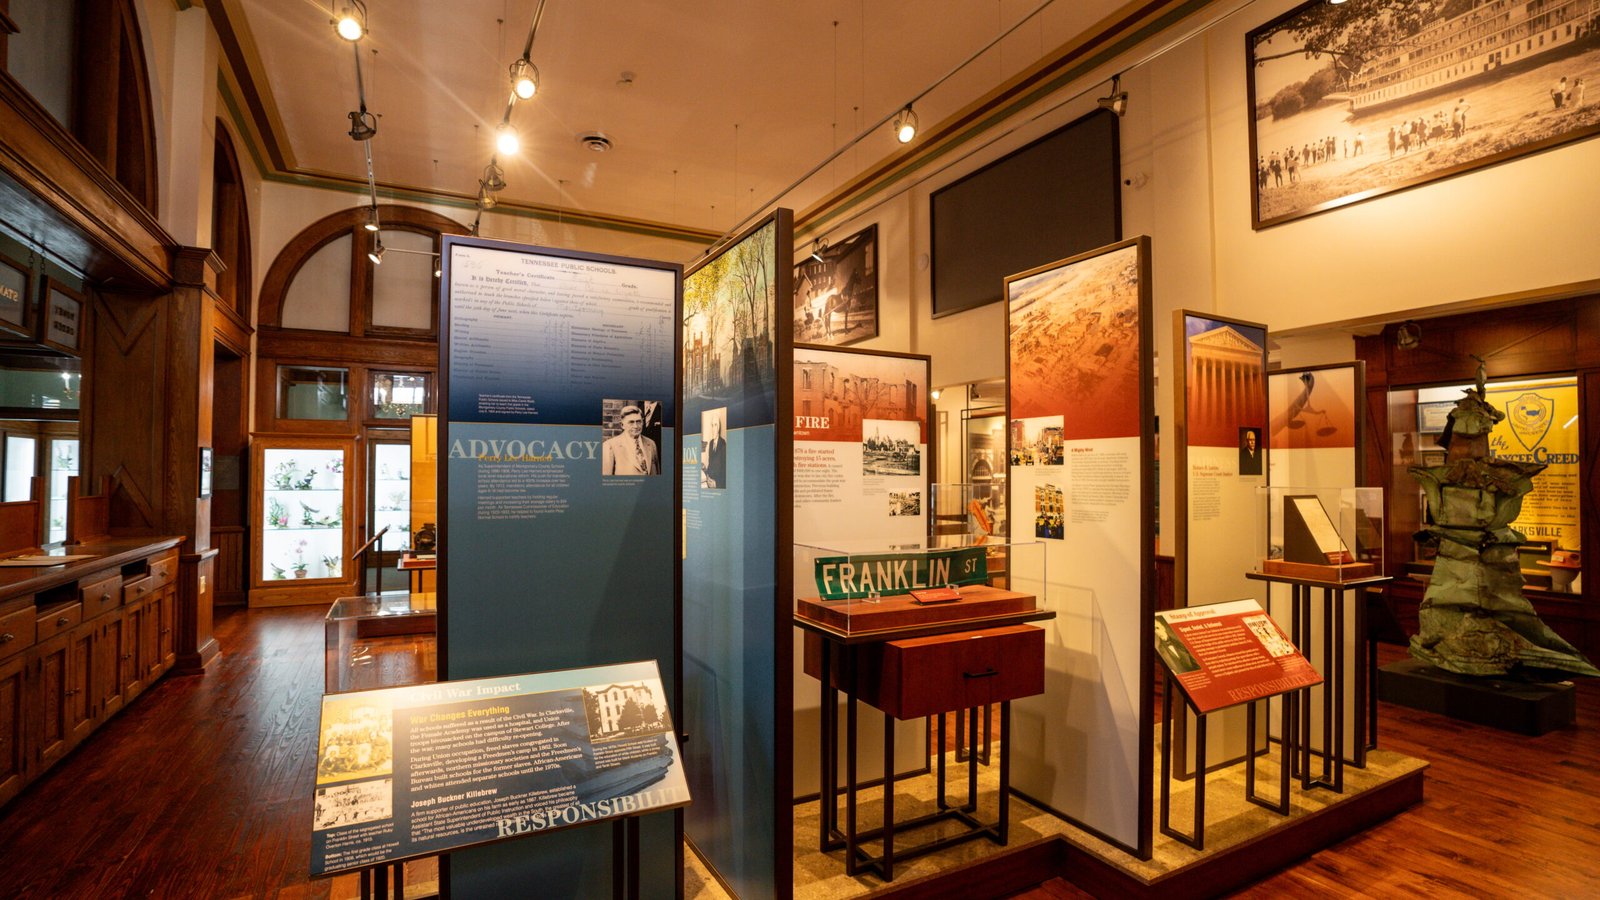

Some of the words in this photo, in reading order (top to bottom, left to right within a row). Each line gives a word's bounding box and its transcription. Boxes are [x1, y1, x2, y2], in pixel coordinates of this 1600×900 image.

[521, 258, 559, 268] TENNESSEE
[560, 263, 585, 272] PUBLIC
[796, 416, 830, 429] FIRE
[448, 438, 600, 460] ADVOCACY
[1490, 436, 1509, 450] the
[1534, 446, 1580, 465] CREED
[1513, 526, 1562, 537] ARKSVILLE
[822, 558, 951, 595] FRANKLIN
[964, 558, 978, 574] ST
[410, 689, 442, 703] Civil
[447, 686, 472, 699] War
[476, 681, 521, 698] Impact
[1228, 674, 1308, 702] RESPONSIBILITY
[410, 714, 427, 725] War
[430, 710, 465, 724] Changes
[467, 704, 510, 719] Everything
[420, 724, 441, 732] schools
[443, 721, 466, 729] suffered
[545, 706, 574, 716] Clarksville,
[411, 739, 429, 748] troops
[483, 729, 505, 738] campus
[534, 722, 554, 731] College.
[421, 730, 442, 738] Female
[443, 727, 469, 736] Academy
[509, 719, 531, 727] hospital,
[411, 754, 431, 764] During
[432, 751, 450, 759] Union
[451, 747, 484, 758] occupation,
[485, 744, 500, 752] freed
[519, 737, 552, 748] congregated
[452, 740, 474, 748] schools
[486, 735, 511, 744] difficulty
[410, 767, 444, 778] afterwards,
[445, 763, 471, 772] northern
[472, 759, 503, 768] missionary
[504, 754, 528, 762] societies
[550, 746, 581, 755] Freedmen's
[411, 760, 444, 771] Clarksville,
[445, 755, 477, 766] developing
[482, 749, 515, 759] Freedmen's
[411, 775, 432, 784] Bureau
[433, 773, 448, 781] built
[449, 769, 471, 778] schools
[493, 763, 512, 771] former
[513, 760, 531, 768] slaves.
[533, 753, 582, 765] African-Americans
[424, 781, 444, 790] whites
[445, 777, 470, 786] attended
[472, 773, 497, 783] separate
[497, 769, 519, 778] schools
[411, 797, 435, 809] Joseph
[437, 792, 464, 803] Buckner
[466, 786, 497, 798] Killebrew
[497, 787, 687, 838] RESPONSIBILIT
